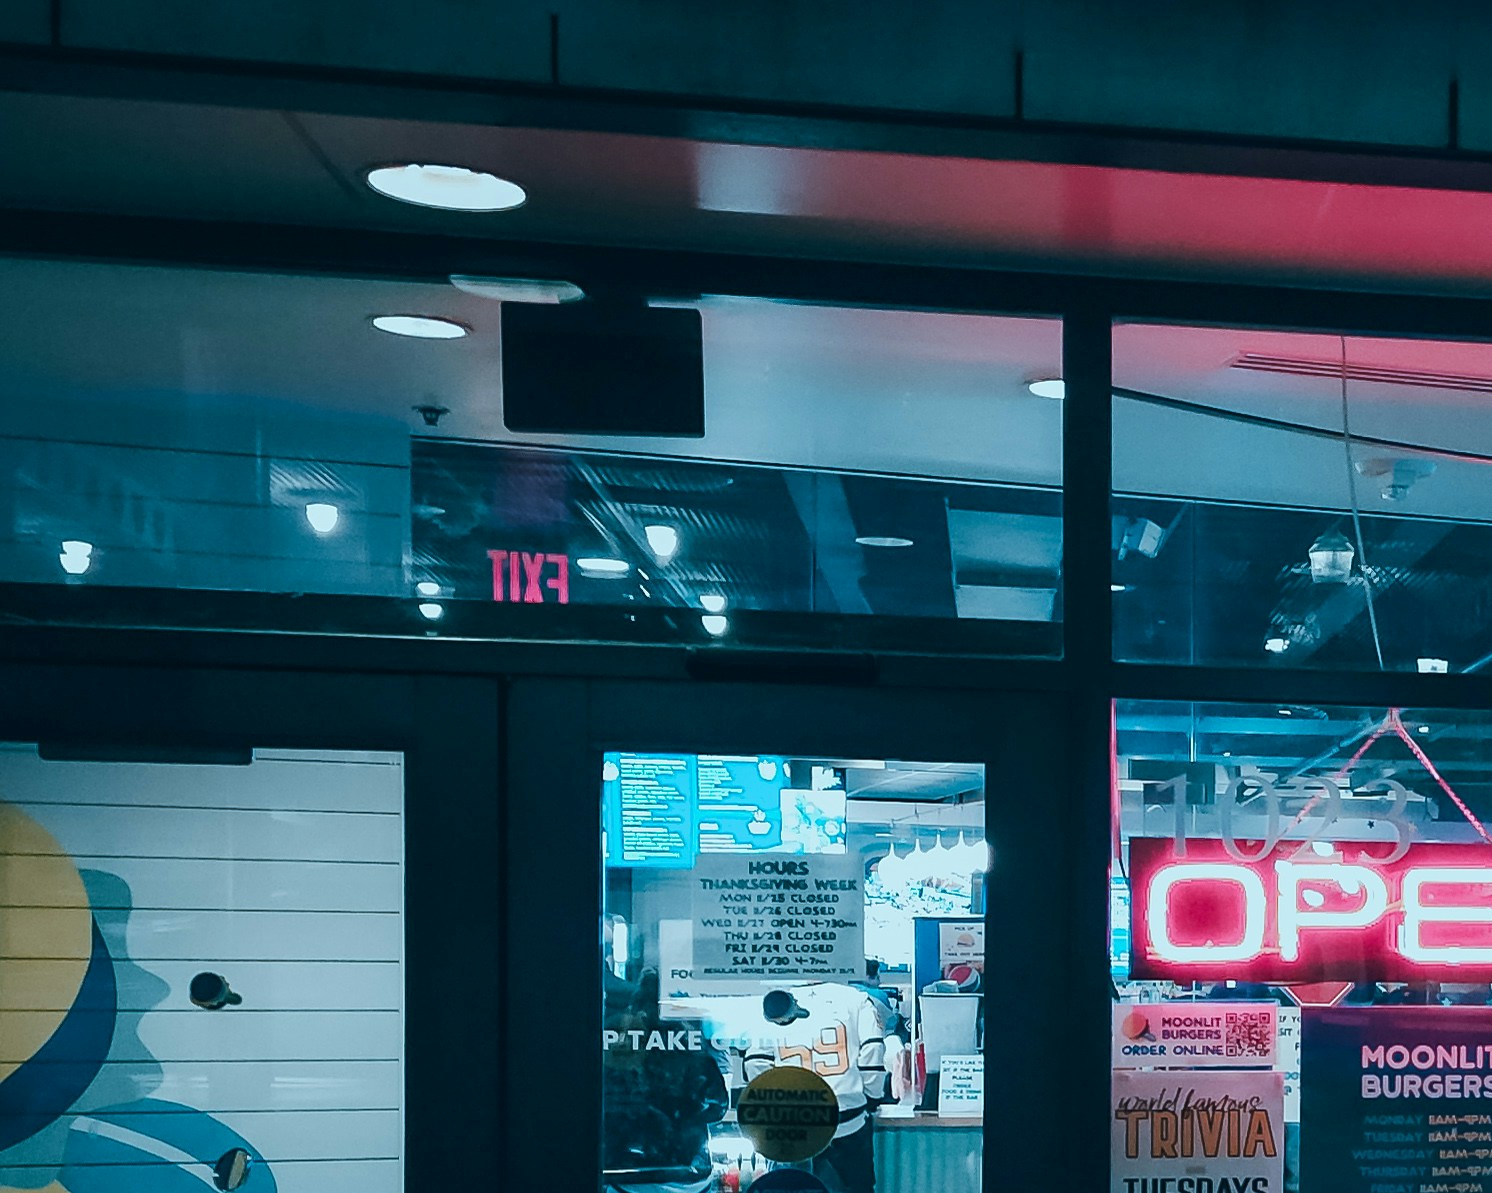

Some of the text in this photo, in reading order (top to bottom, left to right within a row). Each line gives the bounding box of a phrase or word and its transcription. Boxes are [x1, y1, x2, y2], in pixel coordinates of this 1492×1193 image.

[1155, 774, 1412, 864] 1023
[748, 861, 809, 875] HOURS
[700, 878, 857, 890] THANKSGIVING WEEK
[719, 894, 751, 902] MON
[791, 894, 839, 903] CLOSED
[723, 906, 747, 915] TUE
[787, 906, 835, 915] CLOSED
[701, 919, 731, 927] WED
[771, 919, 804, 928] OPEN
[724, 932, 748, 940] THU
[788, 932, 836, 940] CLOSED
[725, 944, 746, 952] FRI
[785, 944, 833, 952] CLOSED
[732, 956, 756, 965] SAT
[1162, 1017, 1221, 1028] MOONLIT
[1162, 1030, 1221, 1040] BURGERS
[1122, 1044, 1224, 1056] ORDER ONLINE
[746, 1089, 828, 1101] AUTOMATIC
[1118, 1087, 1263, 1119] world famous
[742, 1105, 830, 1123] CAUTION
[1363, 1115, 1423, 1125] MONDAY
[764, 1129, 807, 1142] DOOR
[1115, 1109, 1277, 1158] TRIVIA
[1364, 1132, 1423, 1142] TUESDAY
[1352, 1149, 1434, 1159] WEDNESDAY
[1359, 1166, 1426, 1176] THURSDAY
[1370, 1184, 1414, 1193] FRIDAY
